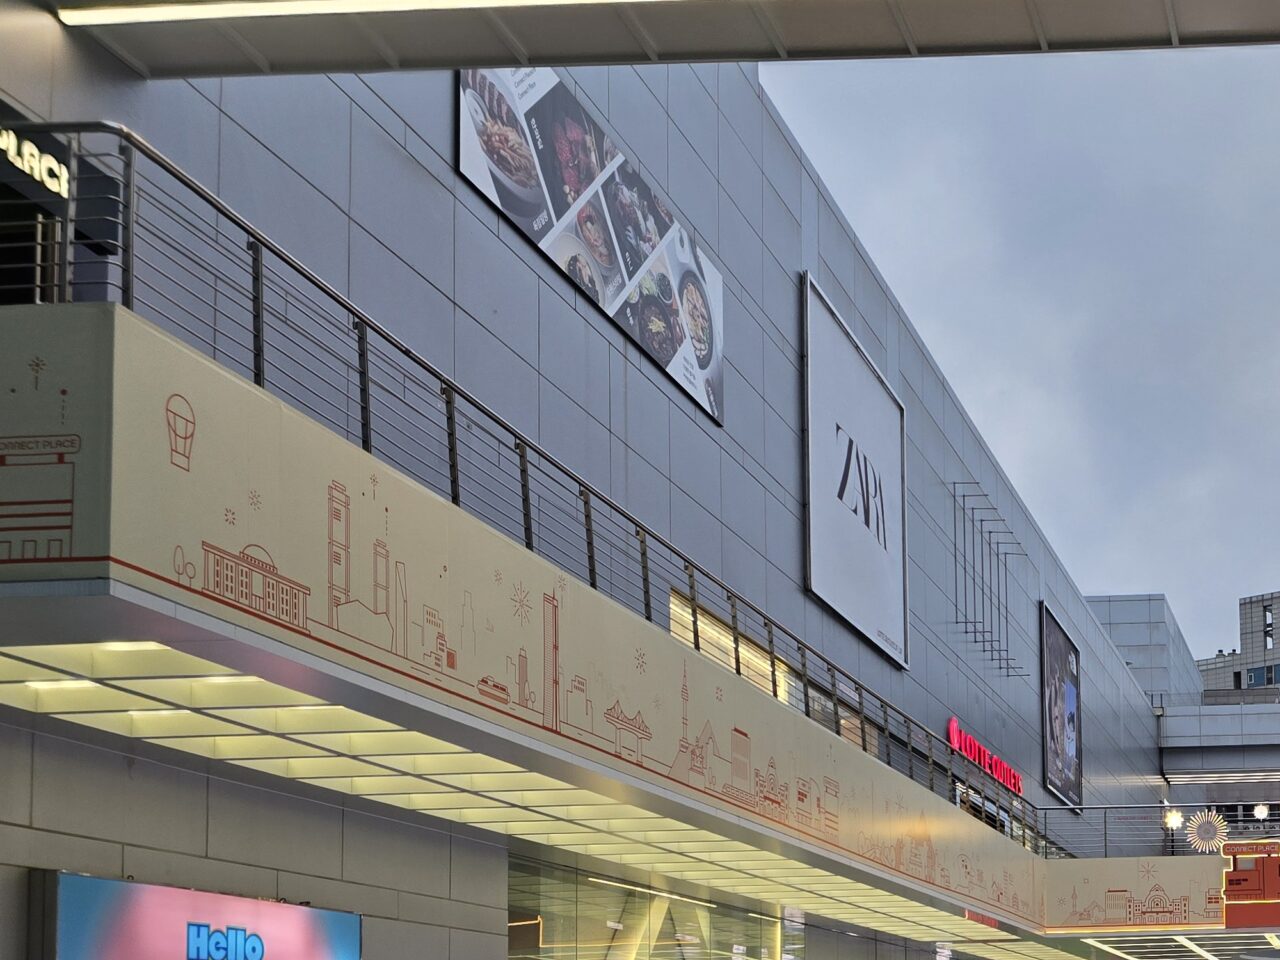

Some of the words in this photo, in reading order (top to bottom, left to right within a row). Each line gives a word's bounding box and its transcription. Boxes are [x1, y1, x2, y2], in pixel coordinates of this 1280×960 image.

[835, 422, 889, 551] ZARA
[961, 729, 992, 774] LOTTE
[991, 755, 1024, 796] OUTLETS
